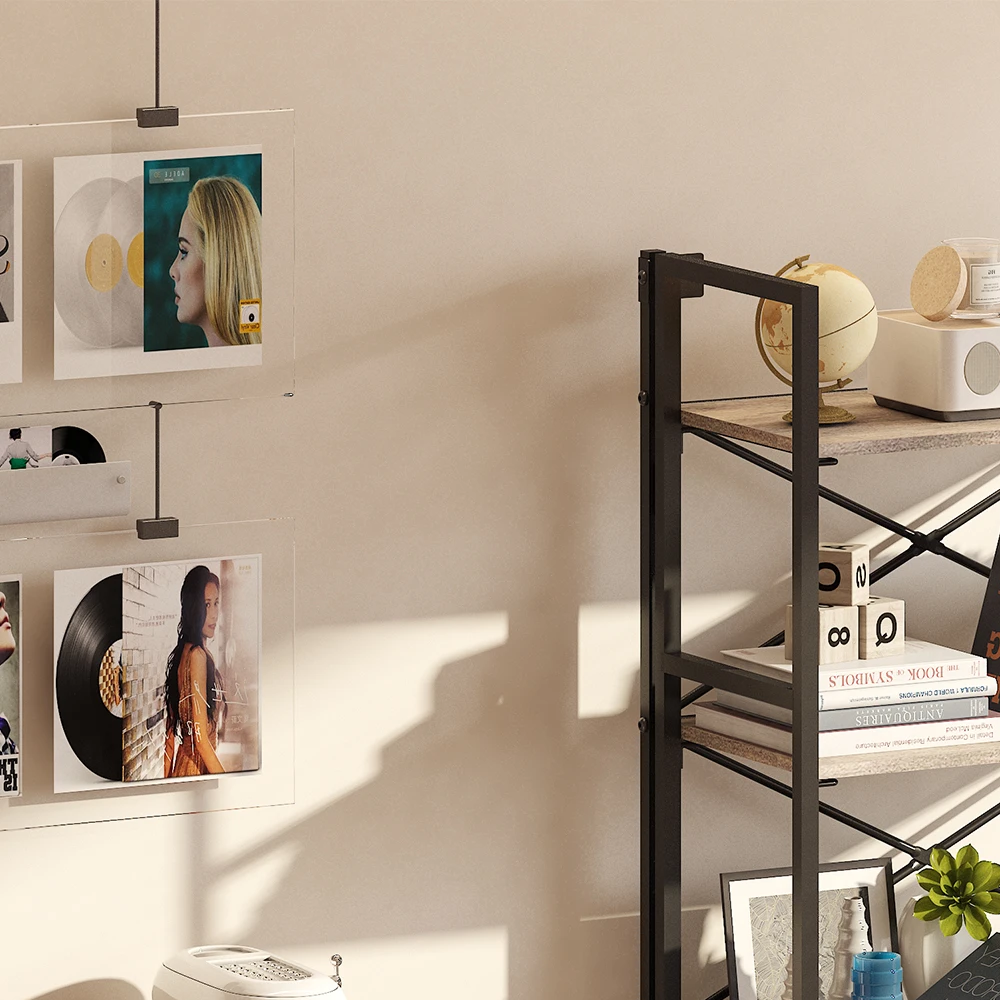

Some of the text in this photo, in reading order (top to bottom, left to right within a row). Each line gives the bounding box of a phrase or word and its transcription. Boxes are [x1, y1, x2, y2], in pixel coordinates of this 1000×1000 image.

[827, 626, 850, 647] 8
[828, 665, 944, 688] BOOK SYMBOLS
[899, 689, 933, 699] CHAMPIONS
[855, 708, 943, 726] ANTIQUAIRES
